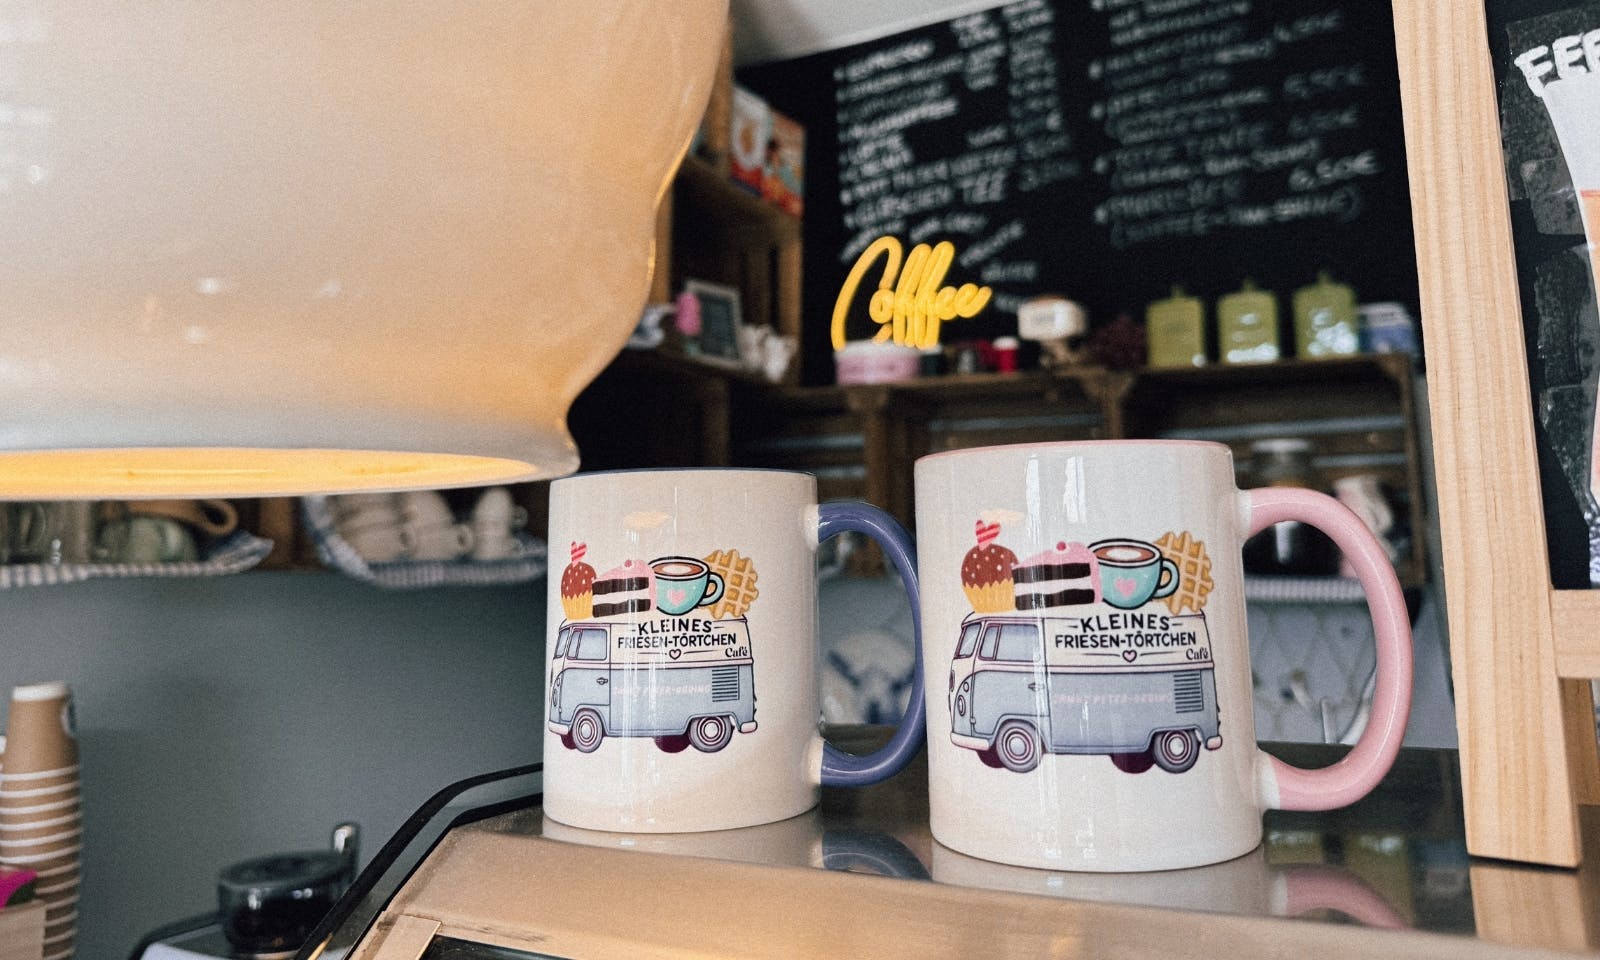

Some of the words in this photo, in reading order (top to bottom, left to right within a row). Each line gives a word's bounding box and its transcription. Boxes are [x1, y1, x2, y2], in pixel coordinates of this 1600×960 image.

[831, 236, 993, 350] Coffee
[638, 618, 713, 635] KLEINES
[1080, 613, 1170, 633] KLEINES
[618, 633, 737, 649] FRIESEN-TÖRTCHEN
[1055, 630, 1196, 649] FRIESEN-TÖRTCHEN
[725, 646, 748, 659] Café
[1185, 648, 1209, 661] Café
